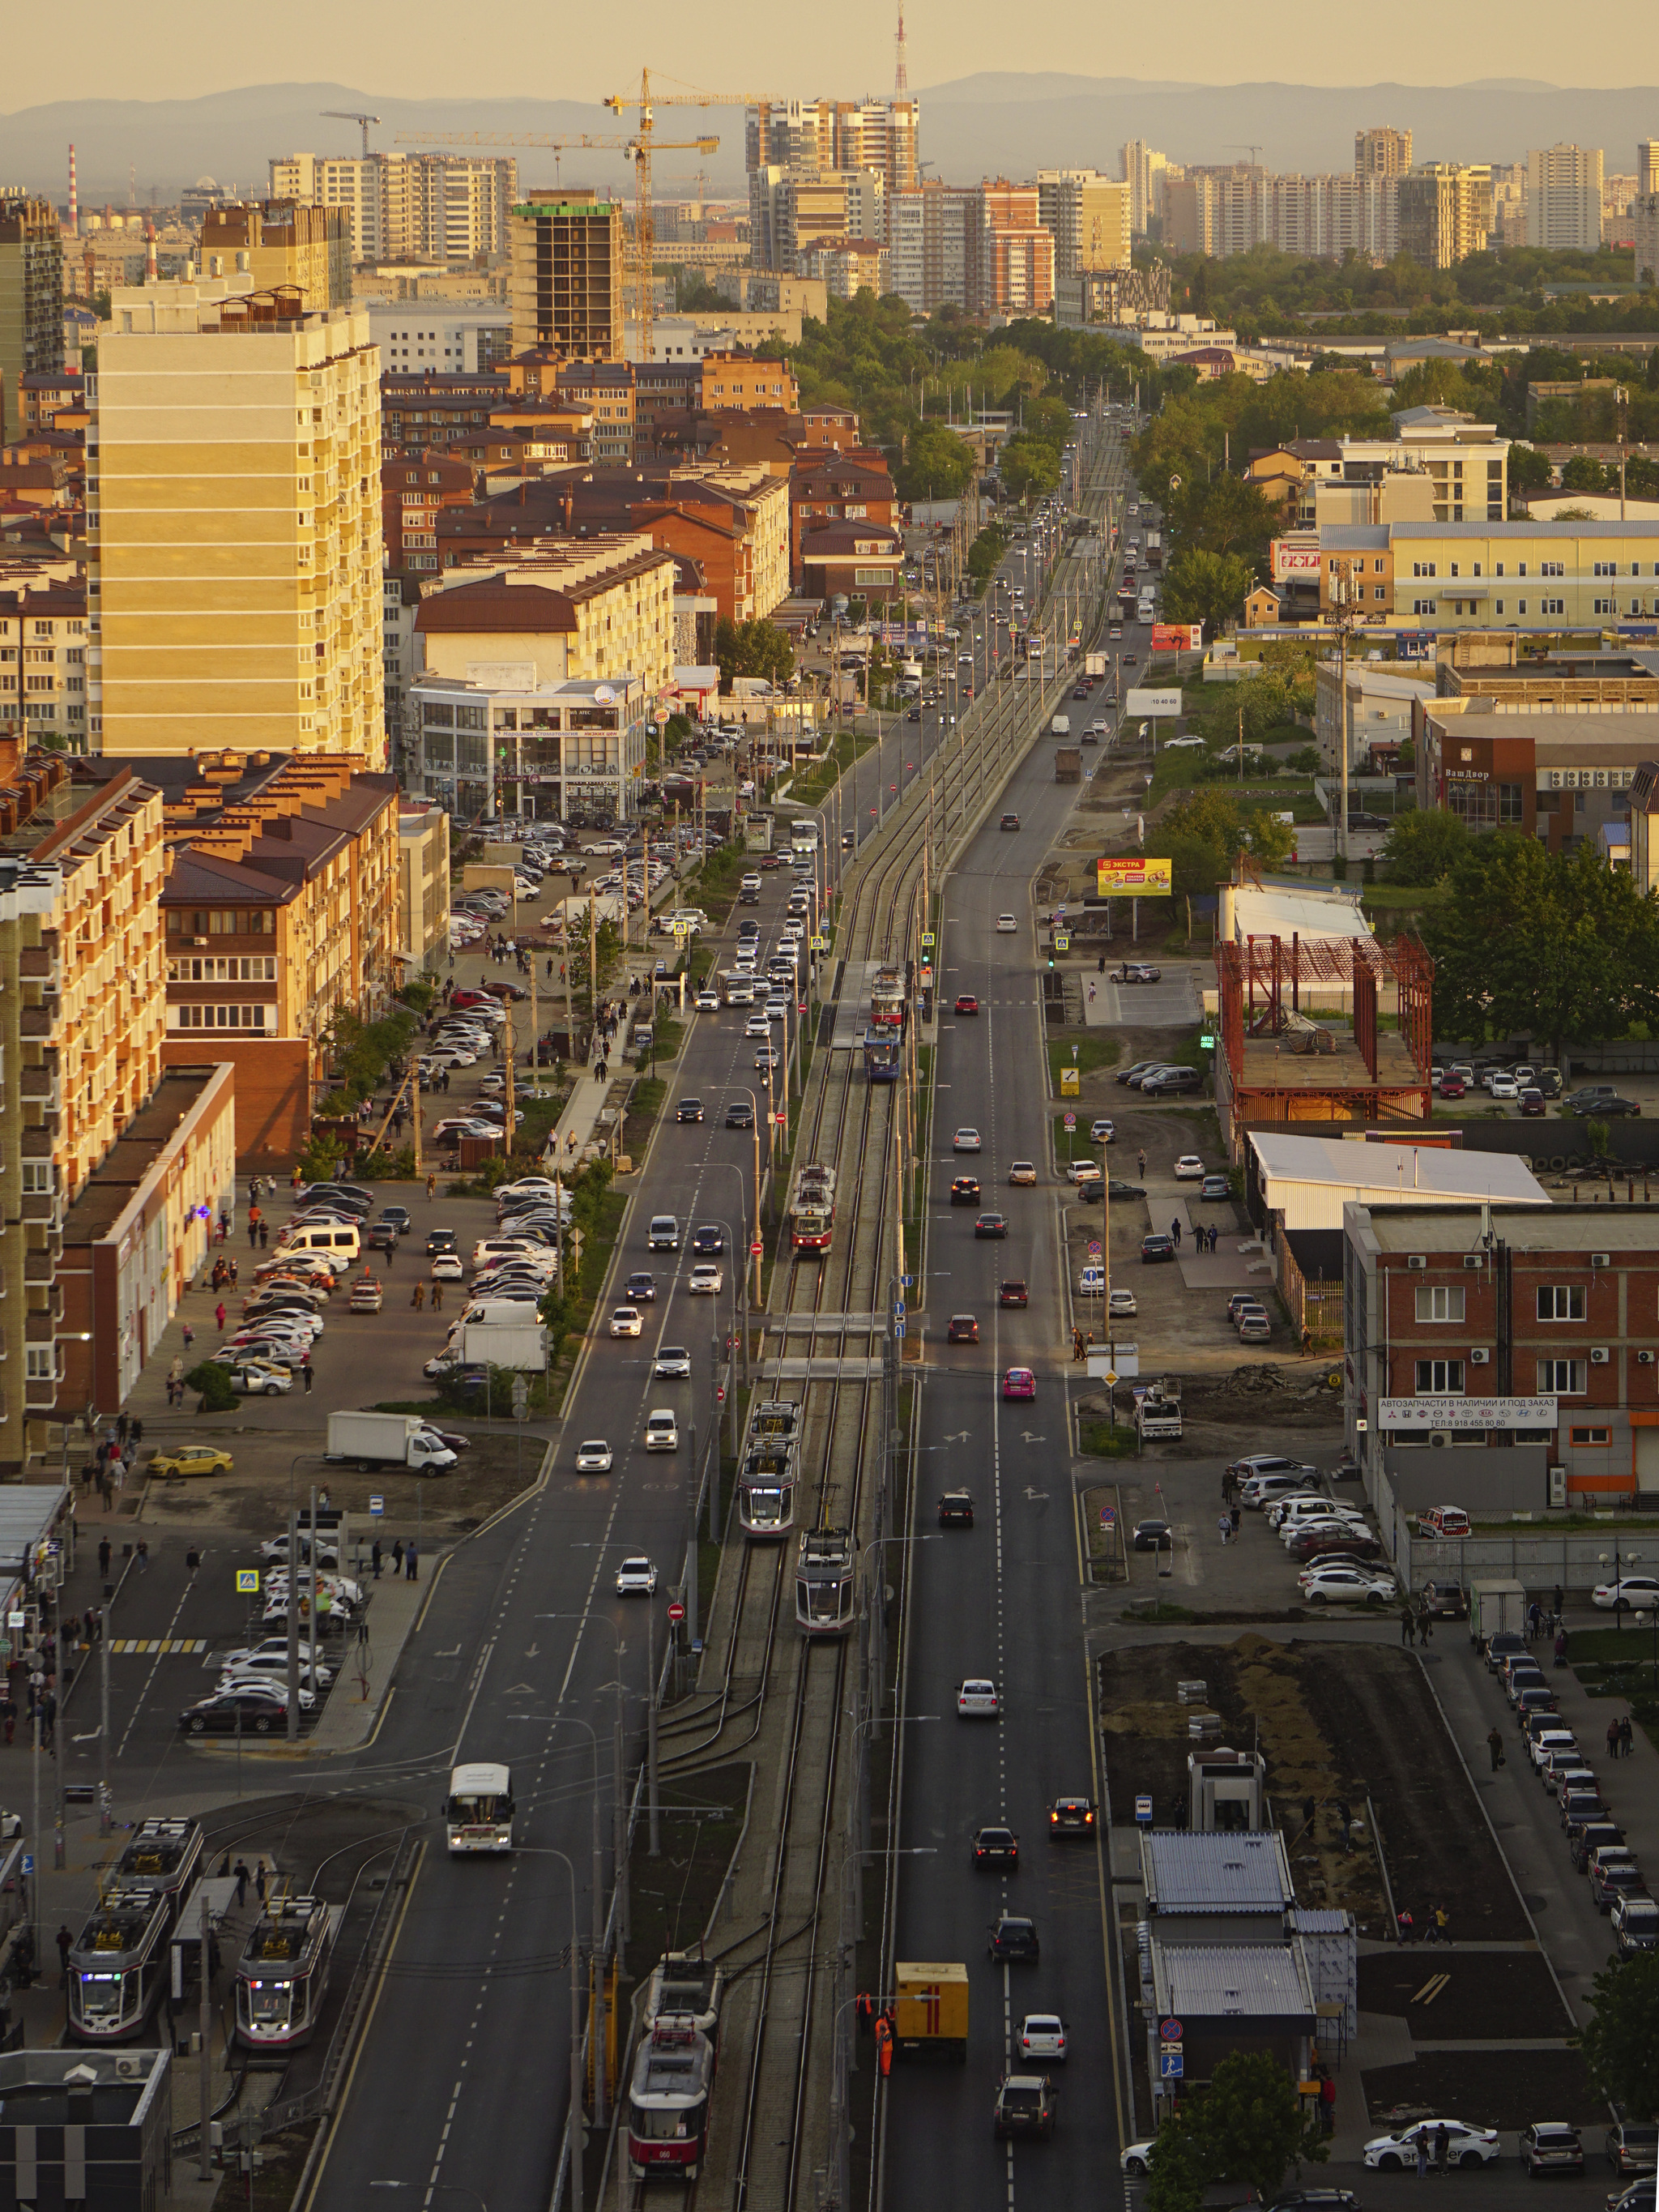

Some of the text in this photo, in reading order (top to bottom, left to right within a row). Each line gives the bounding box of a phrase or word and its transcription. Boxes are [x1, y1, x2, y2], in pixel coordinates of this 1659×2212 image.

[1445, 768, 1490, 781] Ваш Двор
[1380, 1399, 1447, 1407] АВТОЗАПЧАСТИ
[1456, 1399, 1498, 1407] НАЛИЧИИ
[1508, 1399, 1526, 1408] ПОД
[659, 2150, 671, 2159] 060
[1427, 2149, 1463, 2162] uer
